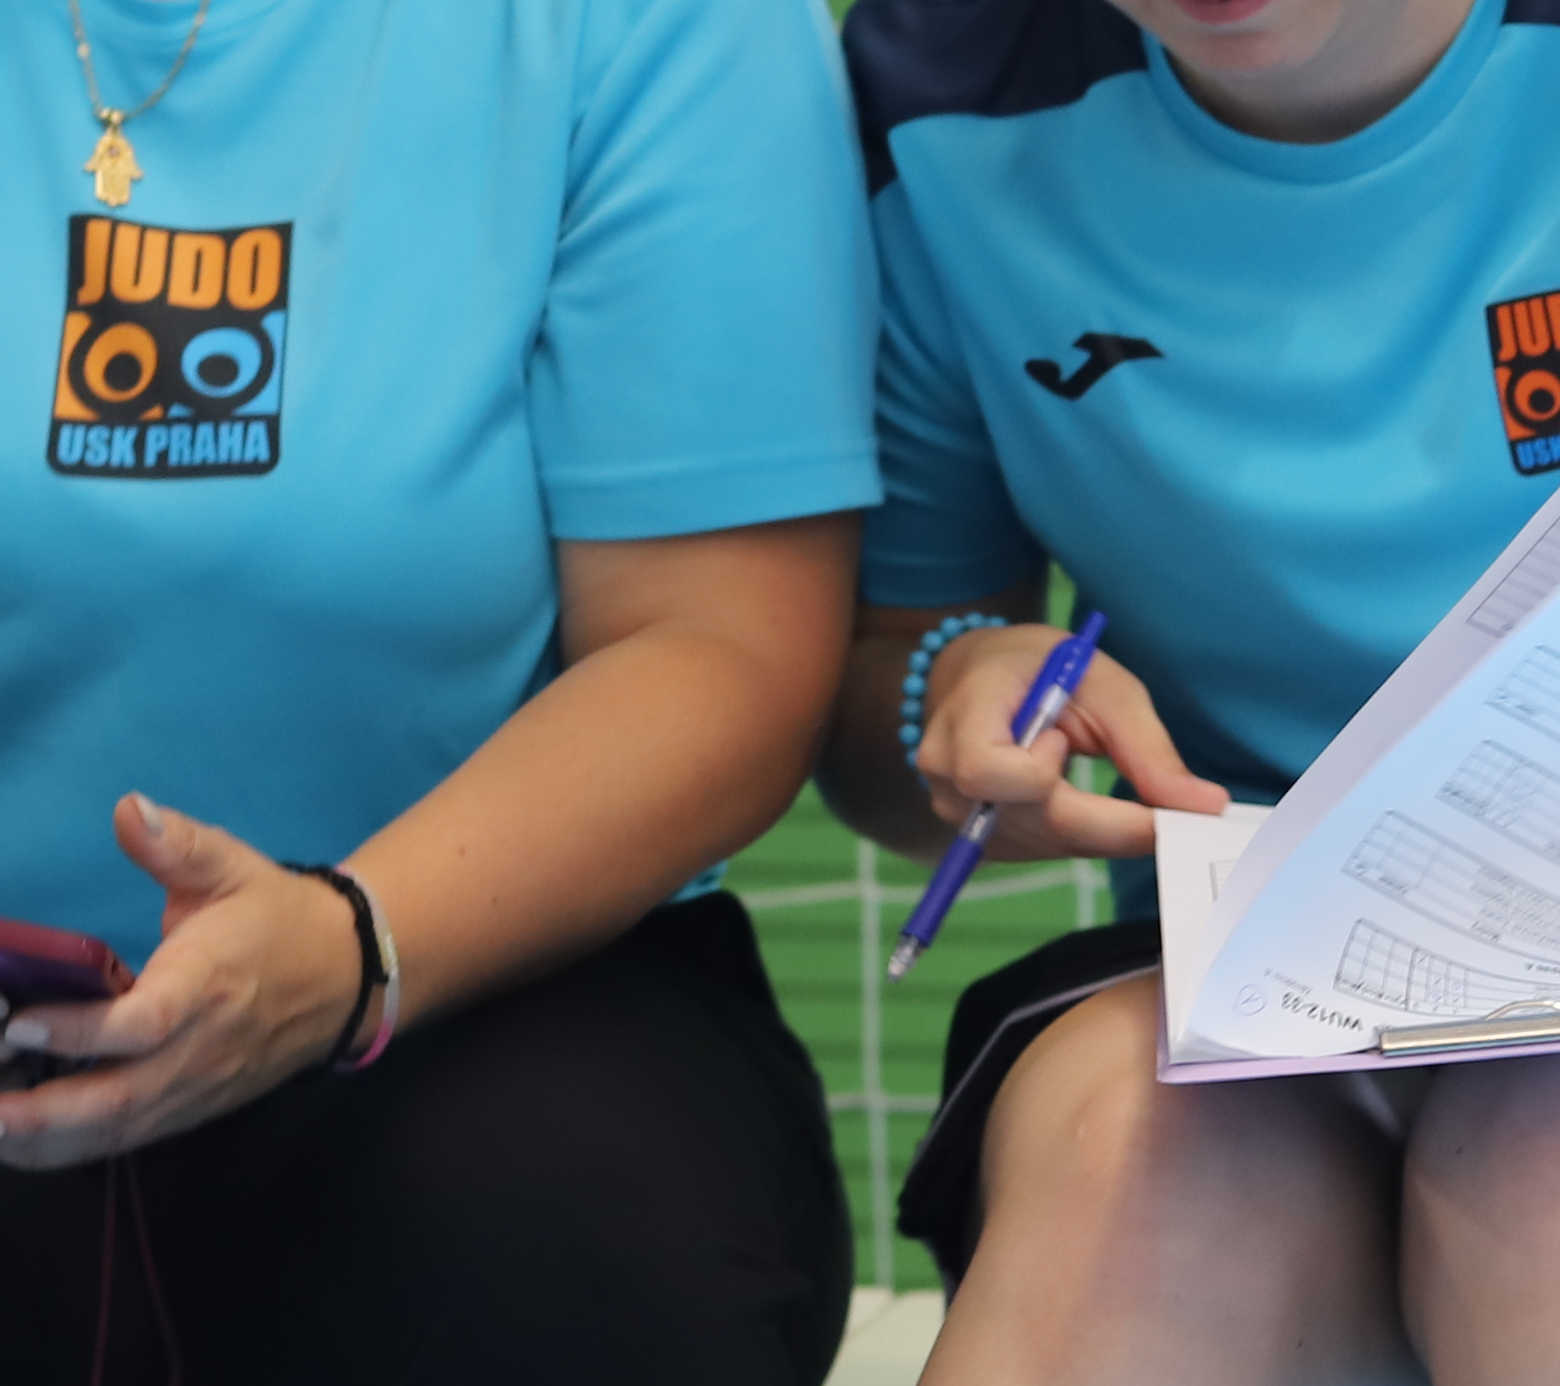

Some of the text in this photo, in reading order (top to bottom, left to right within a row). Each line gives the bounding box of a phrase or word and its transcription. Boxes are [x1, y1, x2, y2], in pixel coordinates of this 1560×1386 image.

[77, 218, 283, 312] JUDO
[56, 420, 271, 468] USK PRAHA
